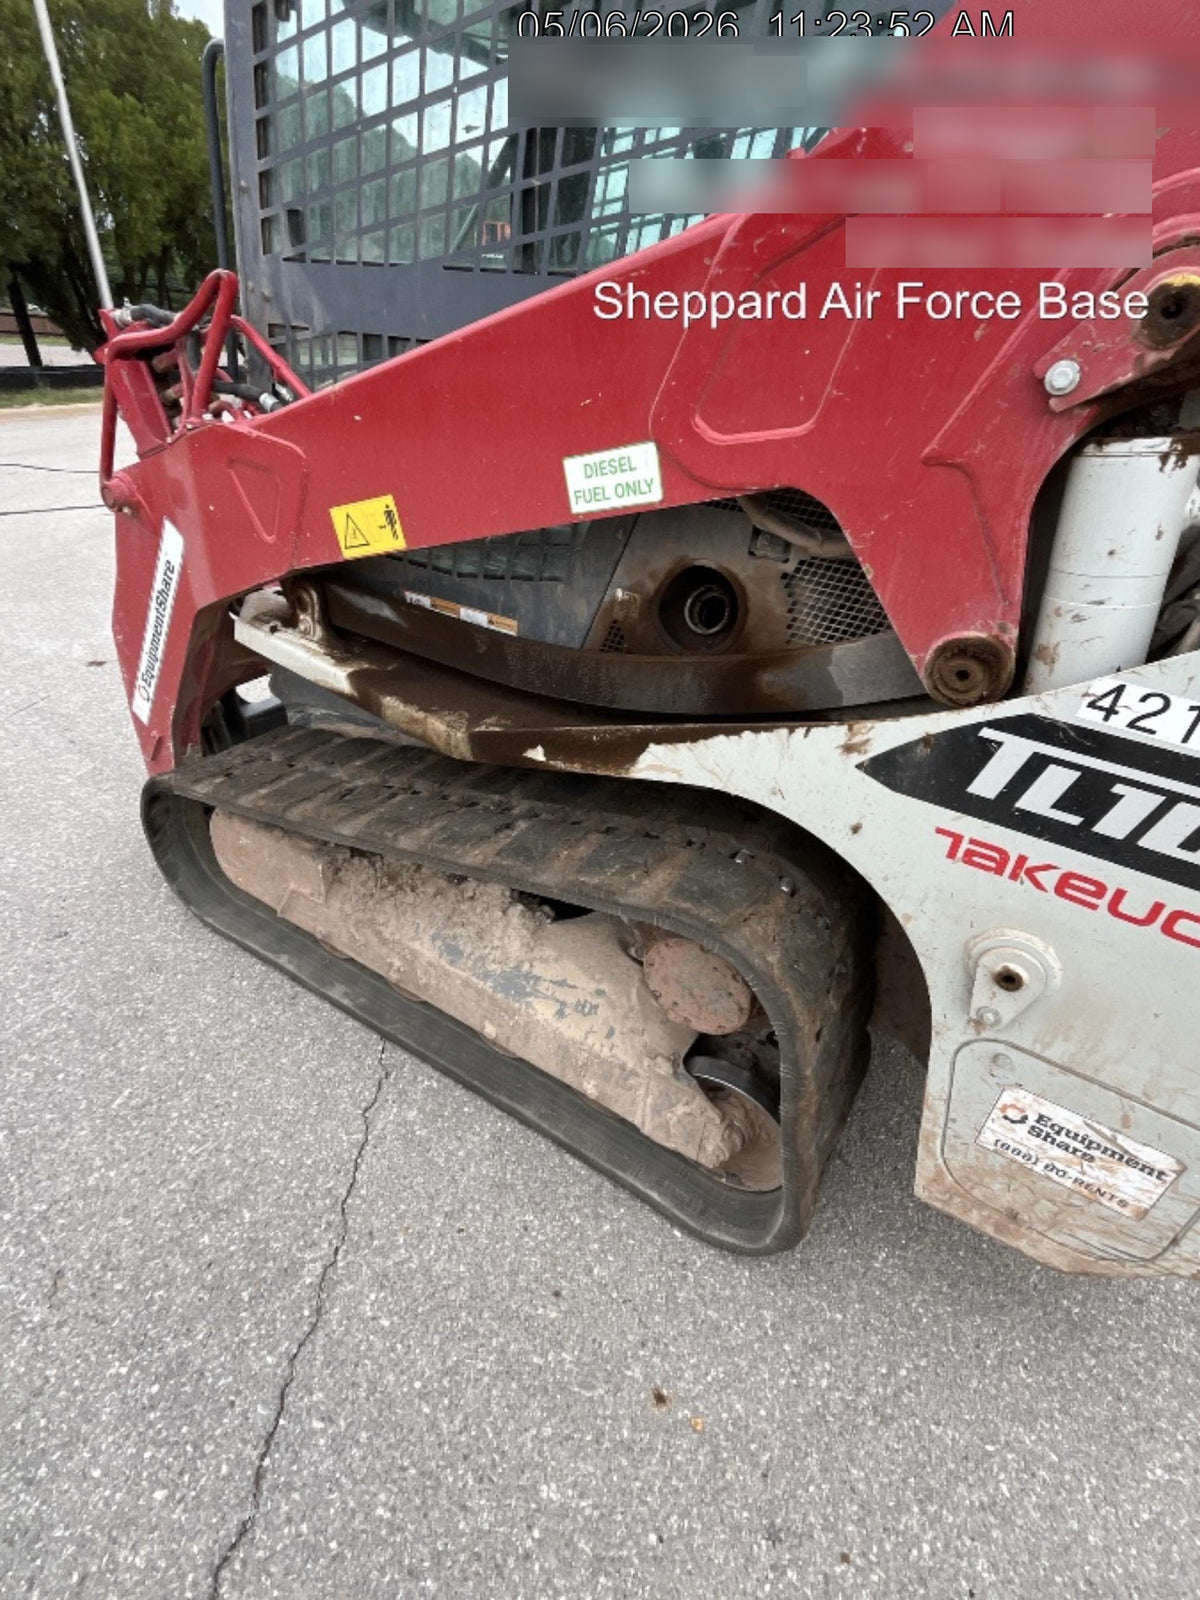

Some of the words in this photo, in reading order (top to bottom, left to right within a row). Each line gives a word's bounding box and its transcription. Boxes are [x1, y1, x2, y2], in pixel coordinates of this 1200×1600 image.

[583, 456, 637, 479] DIESEL
[573, 486, 611, 505] FUEL
[614, 478, 654, 498] ONLY
[140, 559, 175, 689] EquipmentShare
[1026, 1124, 1096, 1164] Share
[1033, 1112, 1169, 1181] Equipment
